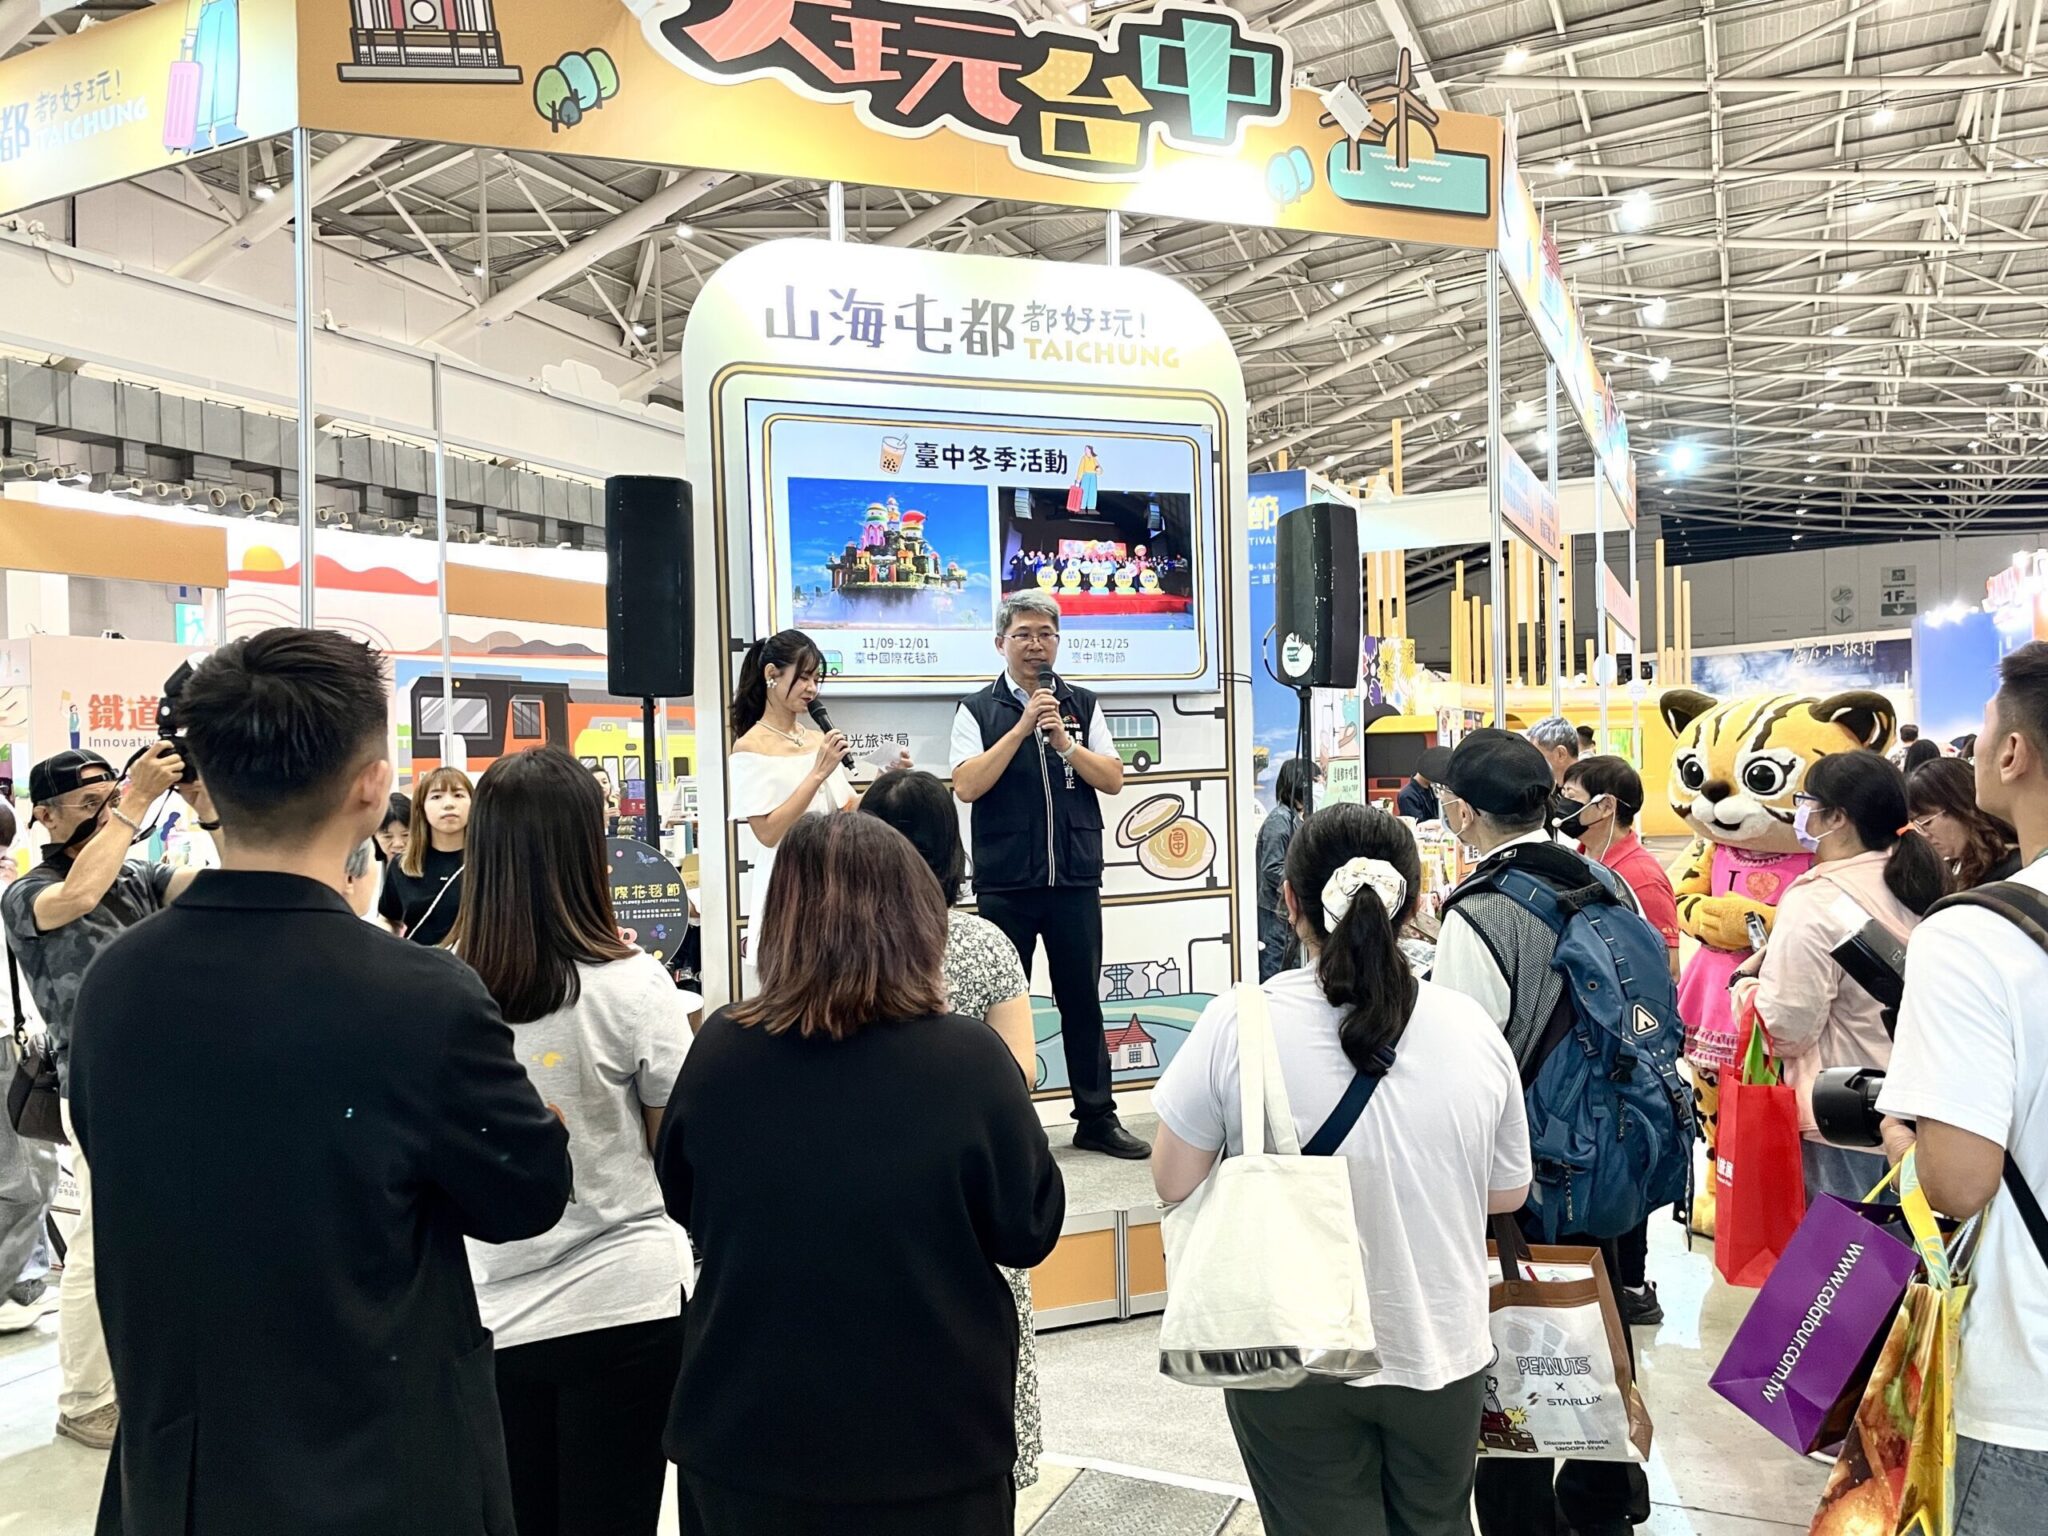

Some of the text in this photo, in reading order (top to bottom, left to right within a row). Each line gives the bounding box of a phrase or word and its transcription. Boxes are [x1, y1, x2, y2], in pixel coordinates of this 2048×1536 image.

[37, 97, 148, 151] TAICHUNG
[765, 285, 1015, 358] 山海屯都
[1023, 337, 1180, 369] TAICHUNG
[914, 441, 1068, 475] 臺中冬季活動
[1884, 590, 1905, 602] 1F
[862, 637, 930, 650] 11/09-12/01
[1067, 637, 1129, 650] 10/24-12/25
[88, 736, 156, 748] Innovativ
[844, 732, 910, 749] 光旅遊局
[1728, 869, 1741, 891] I
[609, 883, 680, 899] 際花毯節
[1762, 1243, 1865, 1404] www.colatour.com.tw
[1516, 1356, 1591, 1376] PEANUTS
[1547, 1395, 1602, 1407] STARLUX
